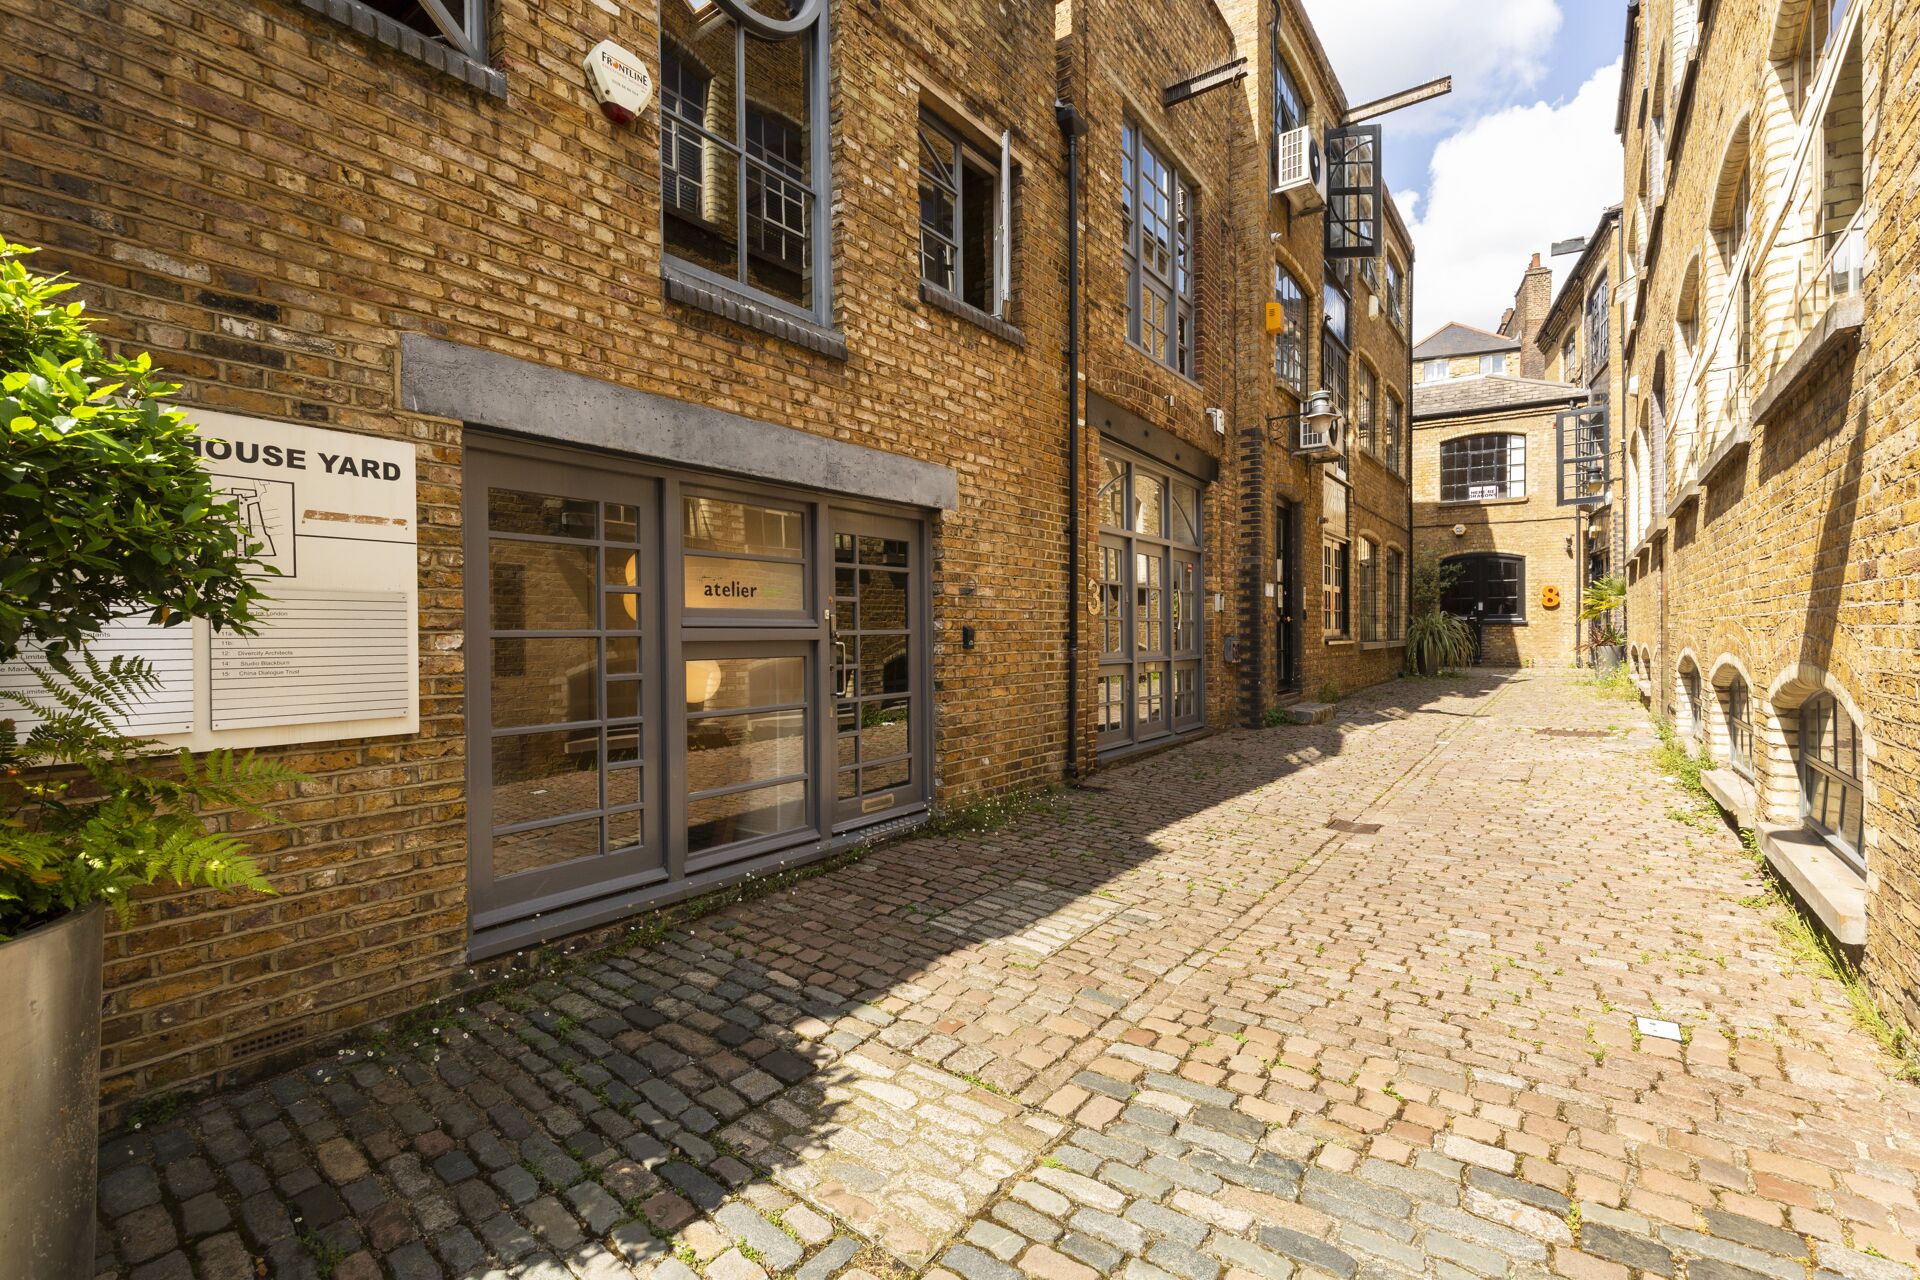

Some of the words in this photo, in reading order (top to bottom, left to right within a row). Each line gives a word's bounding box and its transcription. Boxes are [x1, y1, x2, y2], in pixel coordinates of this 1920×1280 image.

[601, 51, 648, 86] FRONTLINE
[317, 452, 401, 481] YARD
[704, 580, 758, 598] atelier
[1087, 579, 1101, 616] 3
[1541, 585, 1561, 611] 8
